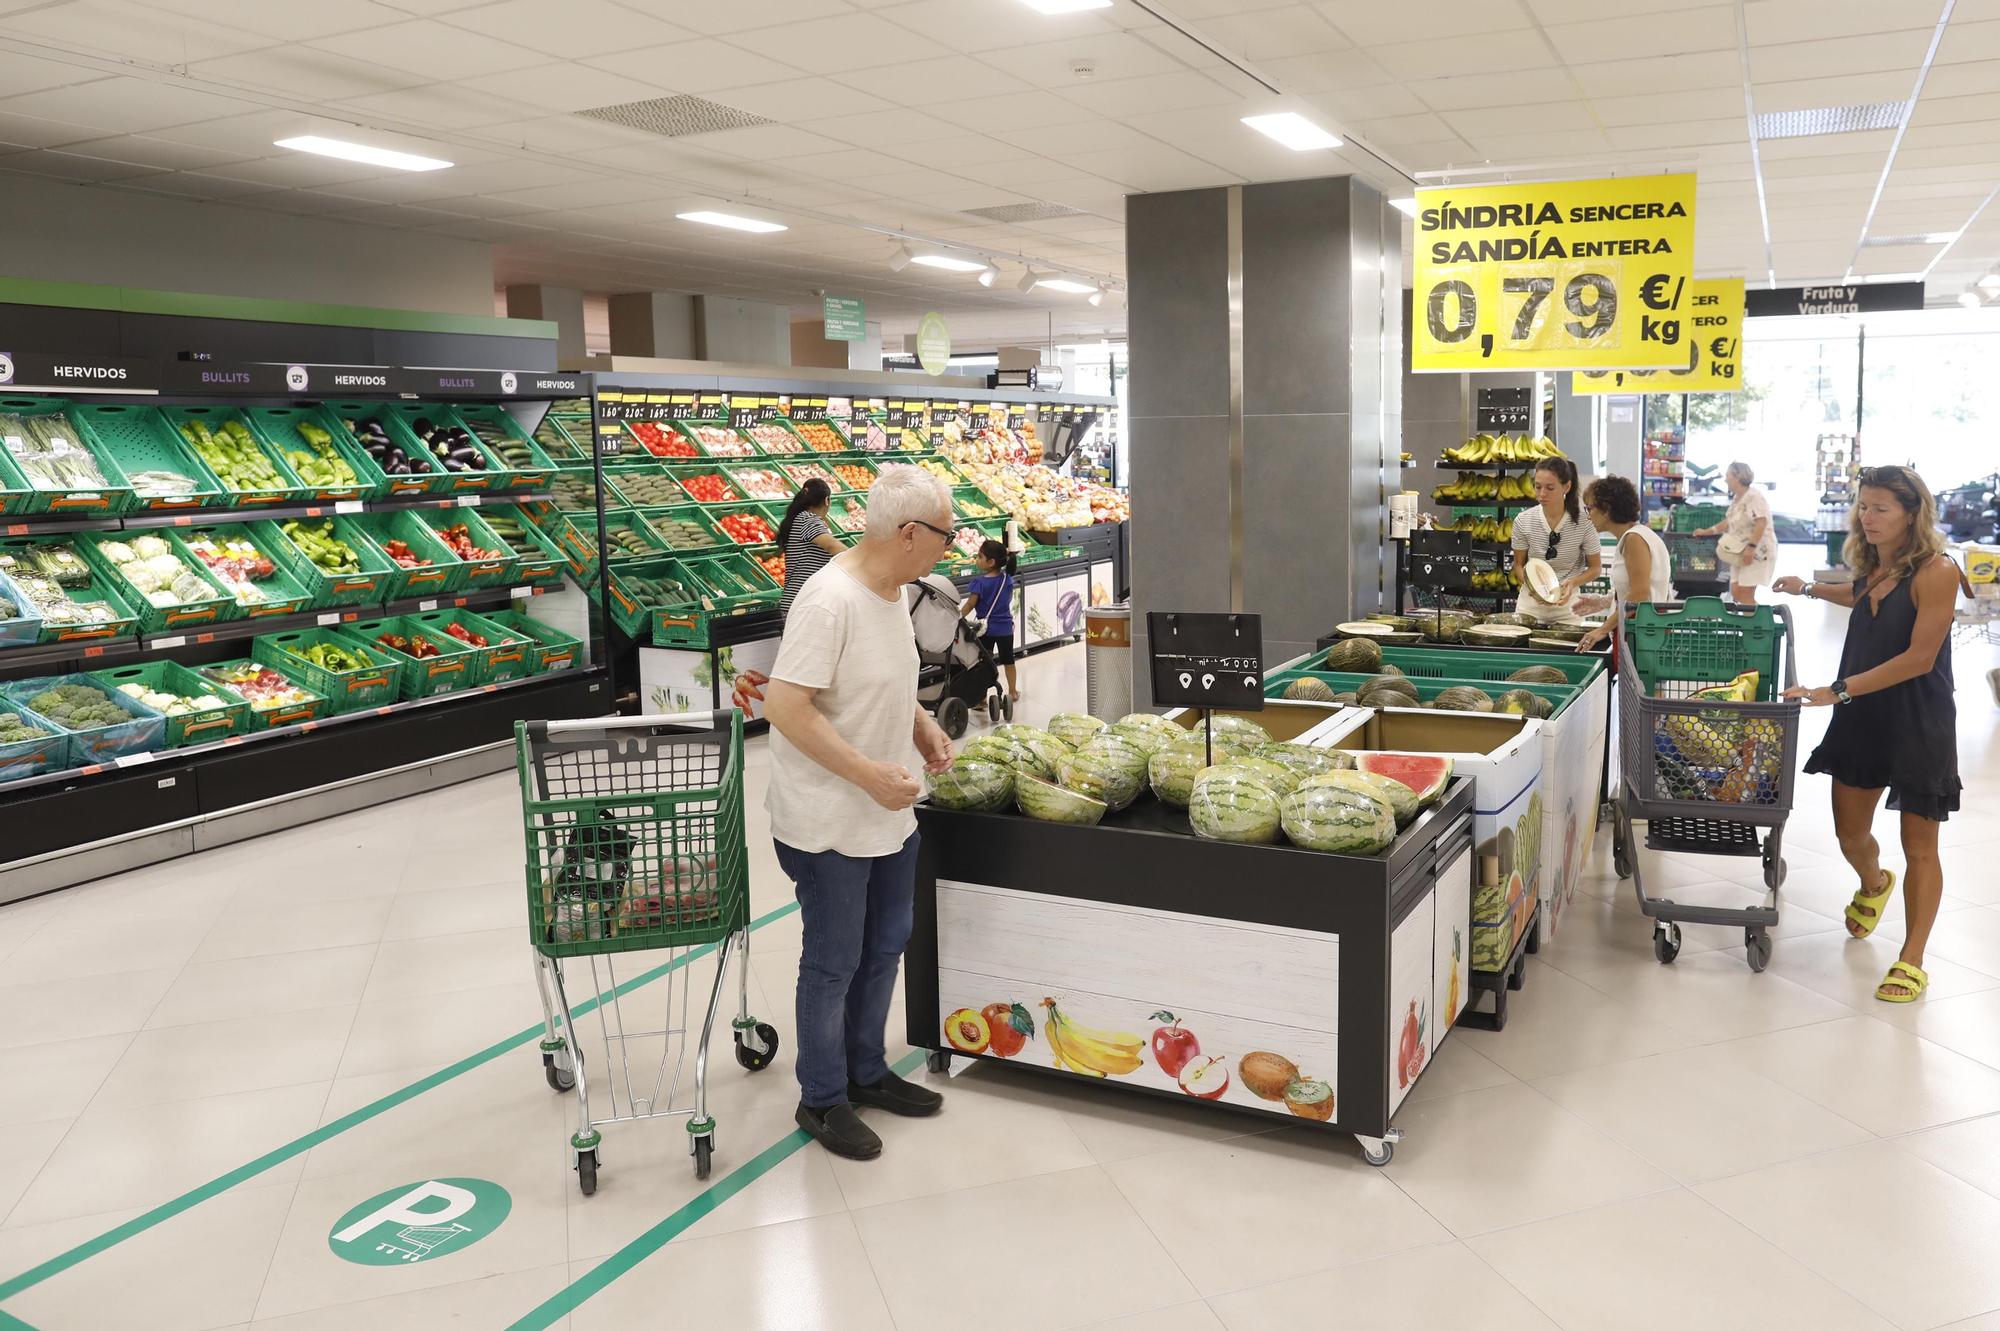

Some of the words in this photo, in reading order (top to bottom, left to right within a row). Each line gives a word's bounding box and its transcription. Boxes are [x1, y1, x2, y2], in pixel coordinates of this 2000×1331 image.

[1421, 201, 1564, 231] SÍNDRIA
[1569, 202, 1687, 222] SENCERA
[1432, 230, 1567, 264] SANDÍA
[1572, 238, 1672, 258] ENTERA
[1803, 286, 1844, 300] Fruta
[1847, 287, 1857, 301] y
[1427, 273, 1617, 357] 0,79
[1798, 301, 1859, 315] Verdura
[1641, 315, 1680, 345] kg
[54, 366, 127, 379] HERVIDOS
[1711, 361, 1734, 378] kg
[202, 371, 250, 383] BULLITS
[334, 375, 386, 386] HERVIDOS
[439, 378, 475, 388] BULLITS
[536, 380, 575, 389] HERVIDOS
[331, 1180, 477, 1243] P
